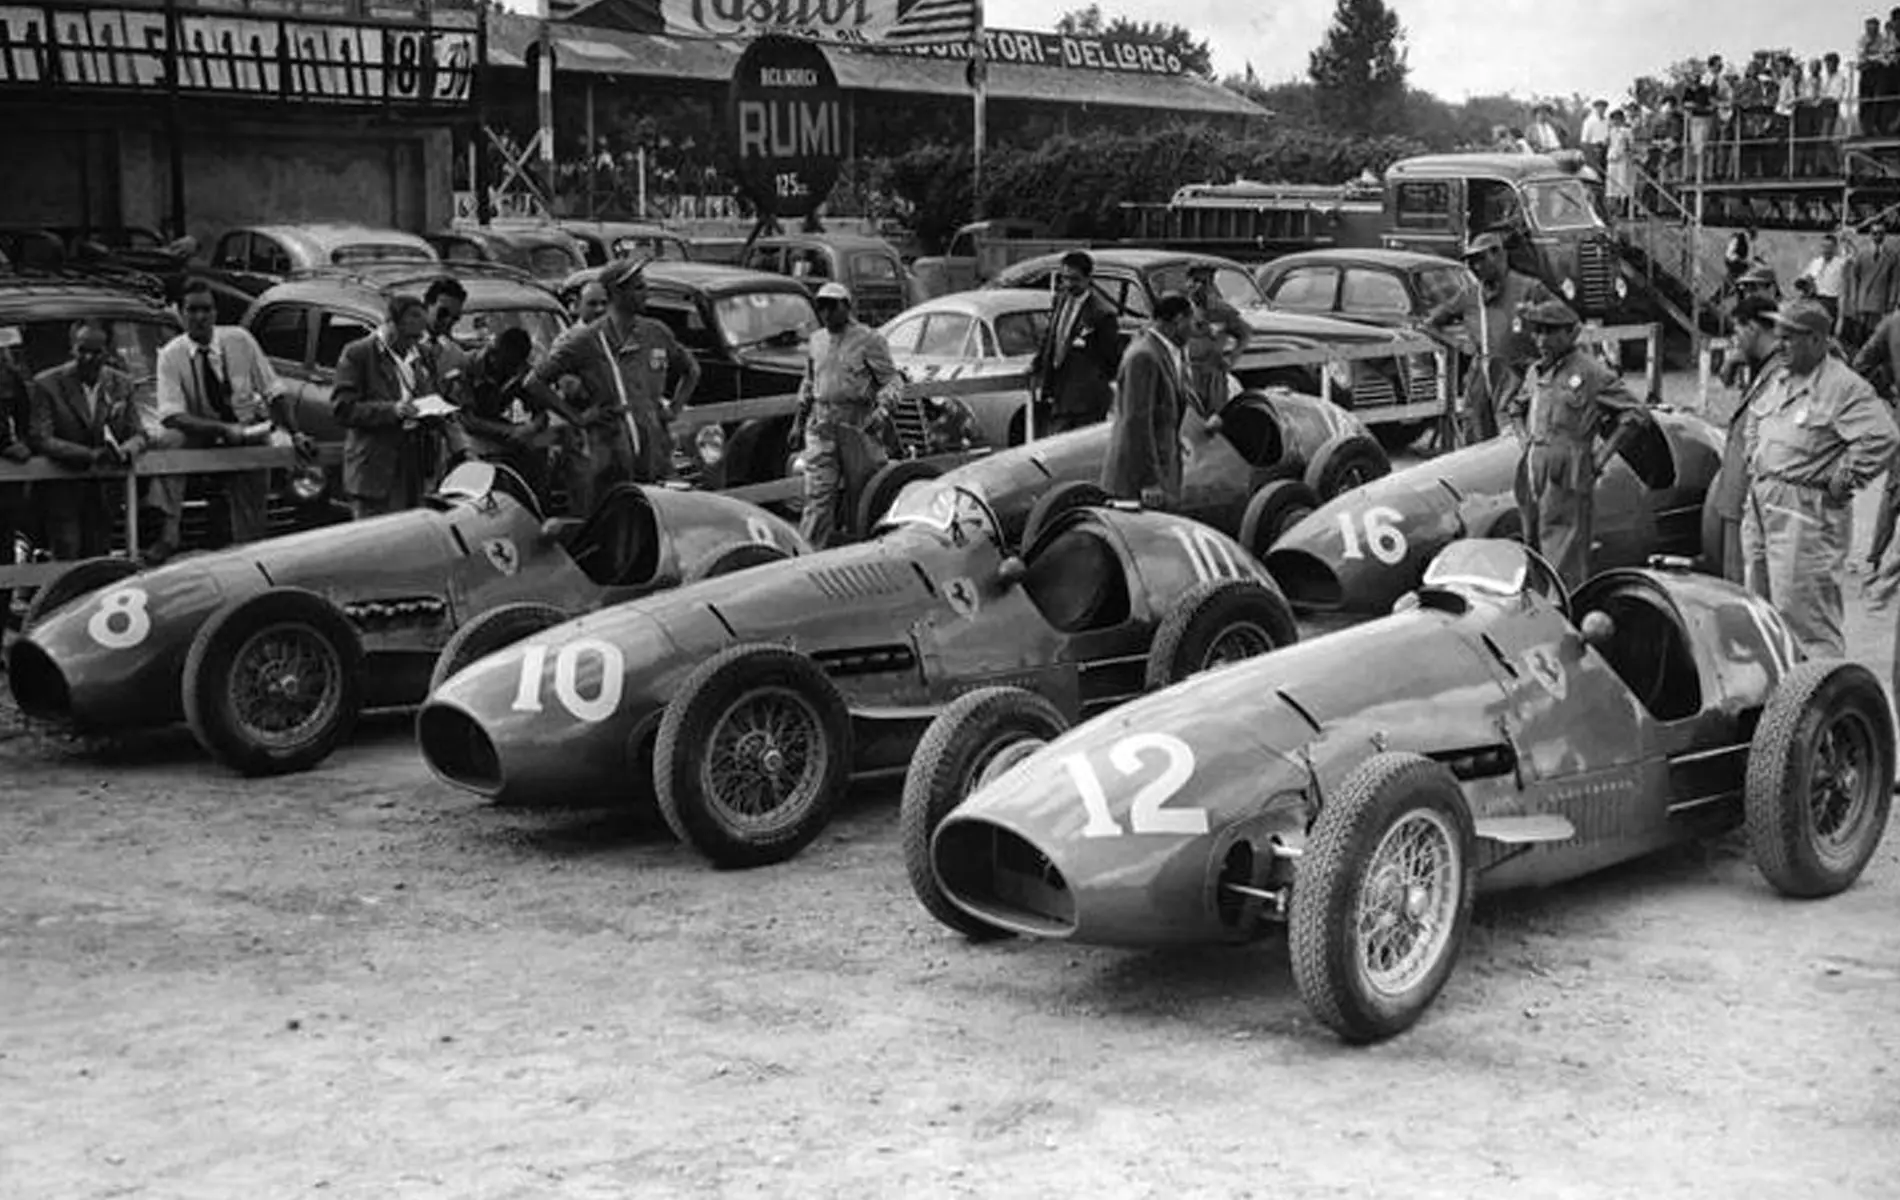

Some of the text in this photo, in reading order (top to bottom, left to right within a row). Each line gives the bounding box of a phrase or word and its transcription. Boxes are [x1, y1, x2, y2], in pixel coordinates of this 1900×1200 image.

[739, 101, 840, 158] RUMI
[1338, 506, 1408, 565] 16
[88, 587, 151, 649] 8
[511, 639, 625, 722] 10
[1059, 732, 1210, 838] 12
